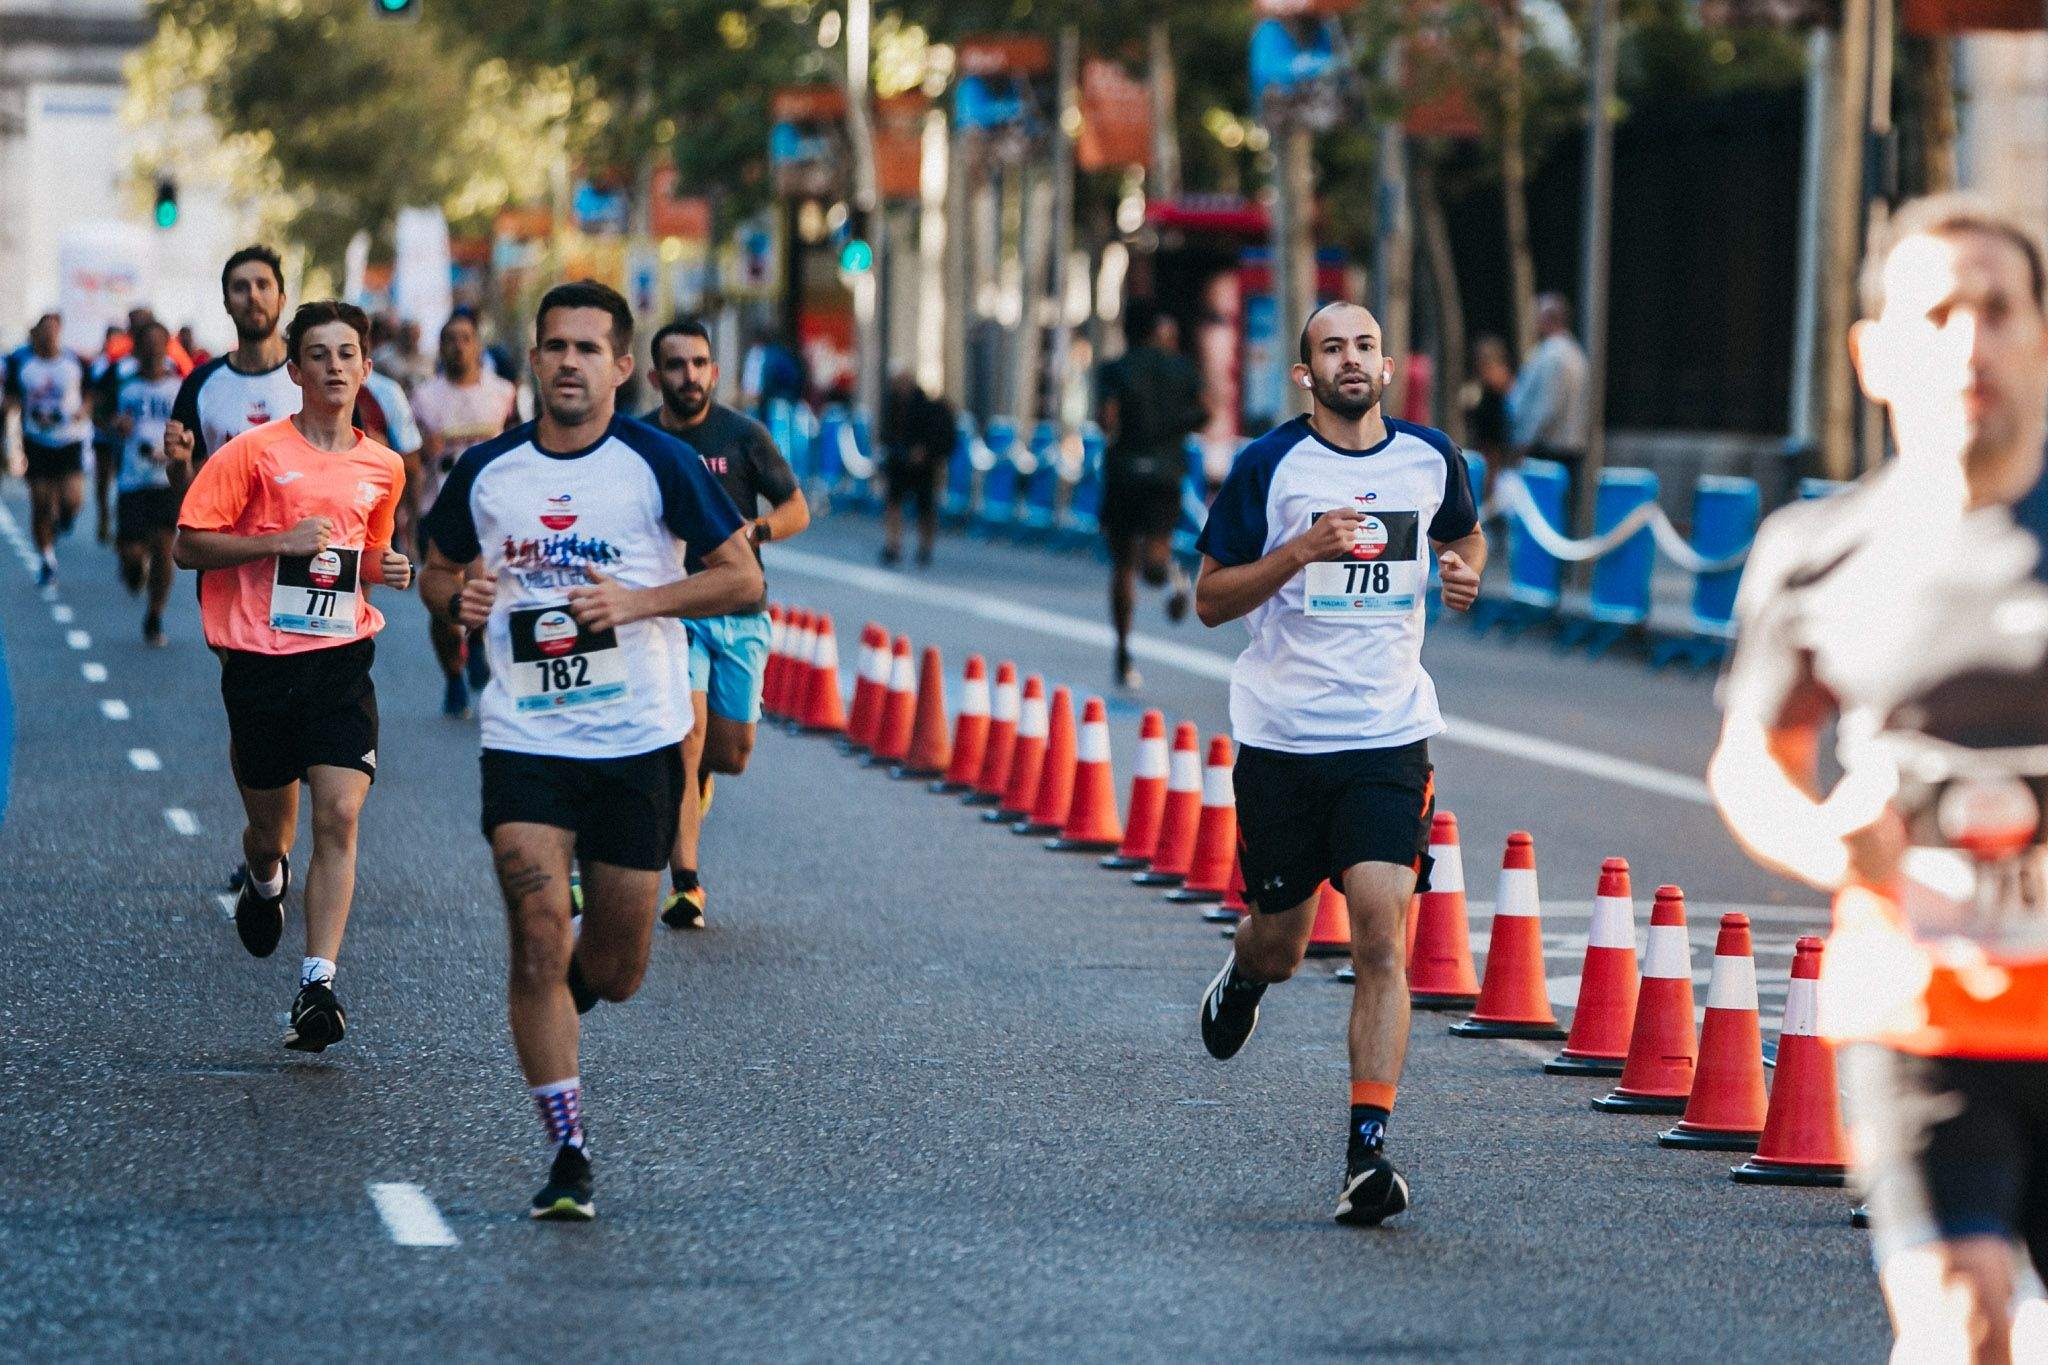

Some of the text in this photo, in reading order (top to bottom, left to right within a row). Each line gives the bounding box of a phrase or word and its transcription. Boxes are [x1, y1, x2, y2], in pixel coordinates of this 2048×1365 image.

[1343, 563, 1389, 594] 778
[306, 589, 337, 618] 777
[535, 655, 592, 693] 782
